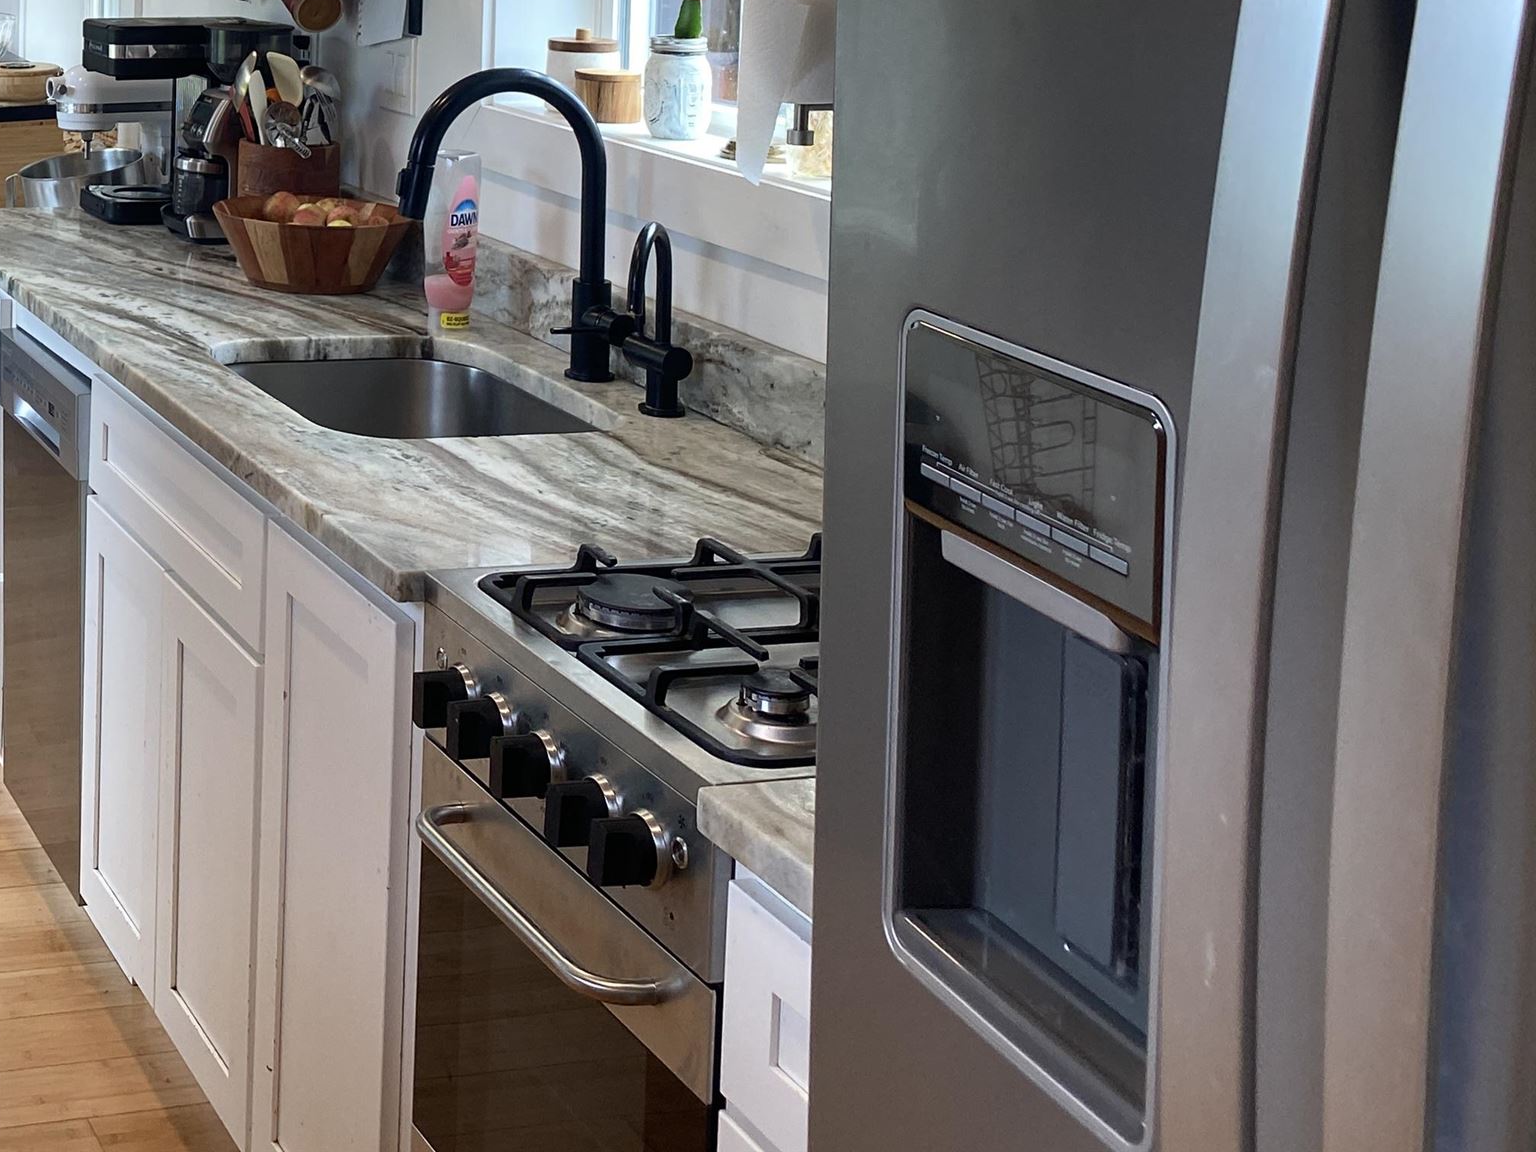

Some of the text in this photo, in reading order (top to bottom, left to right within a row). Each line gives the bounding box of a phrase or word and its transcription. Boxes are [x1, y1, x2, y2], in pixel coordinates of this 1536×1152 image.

[450, 211, 478, 227] DAWN
[1092, 528, 1132, 553] Fridge Temp
